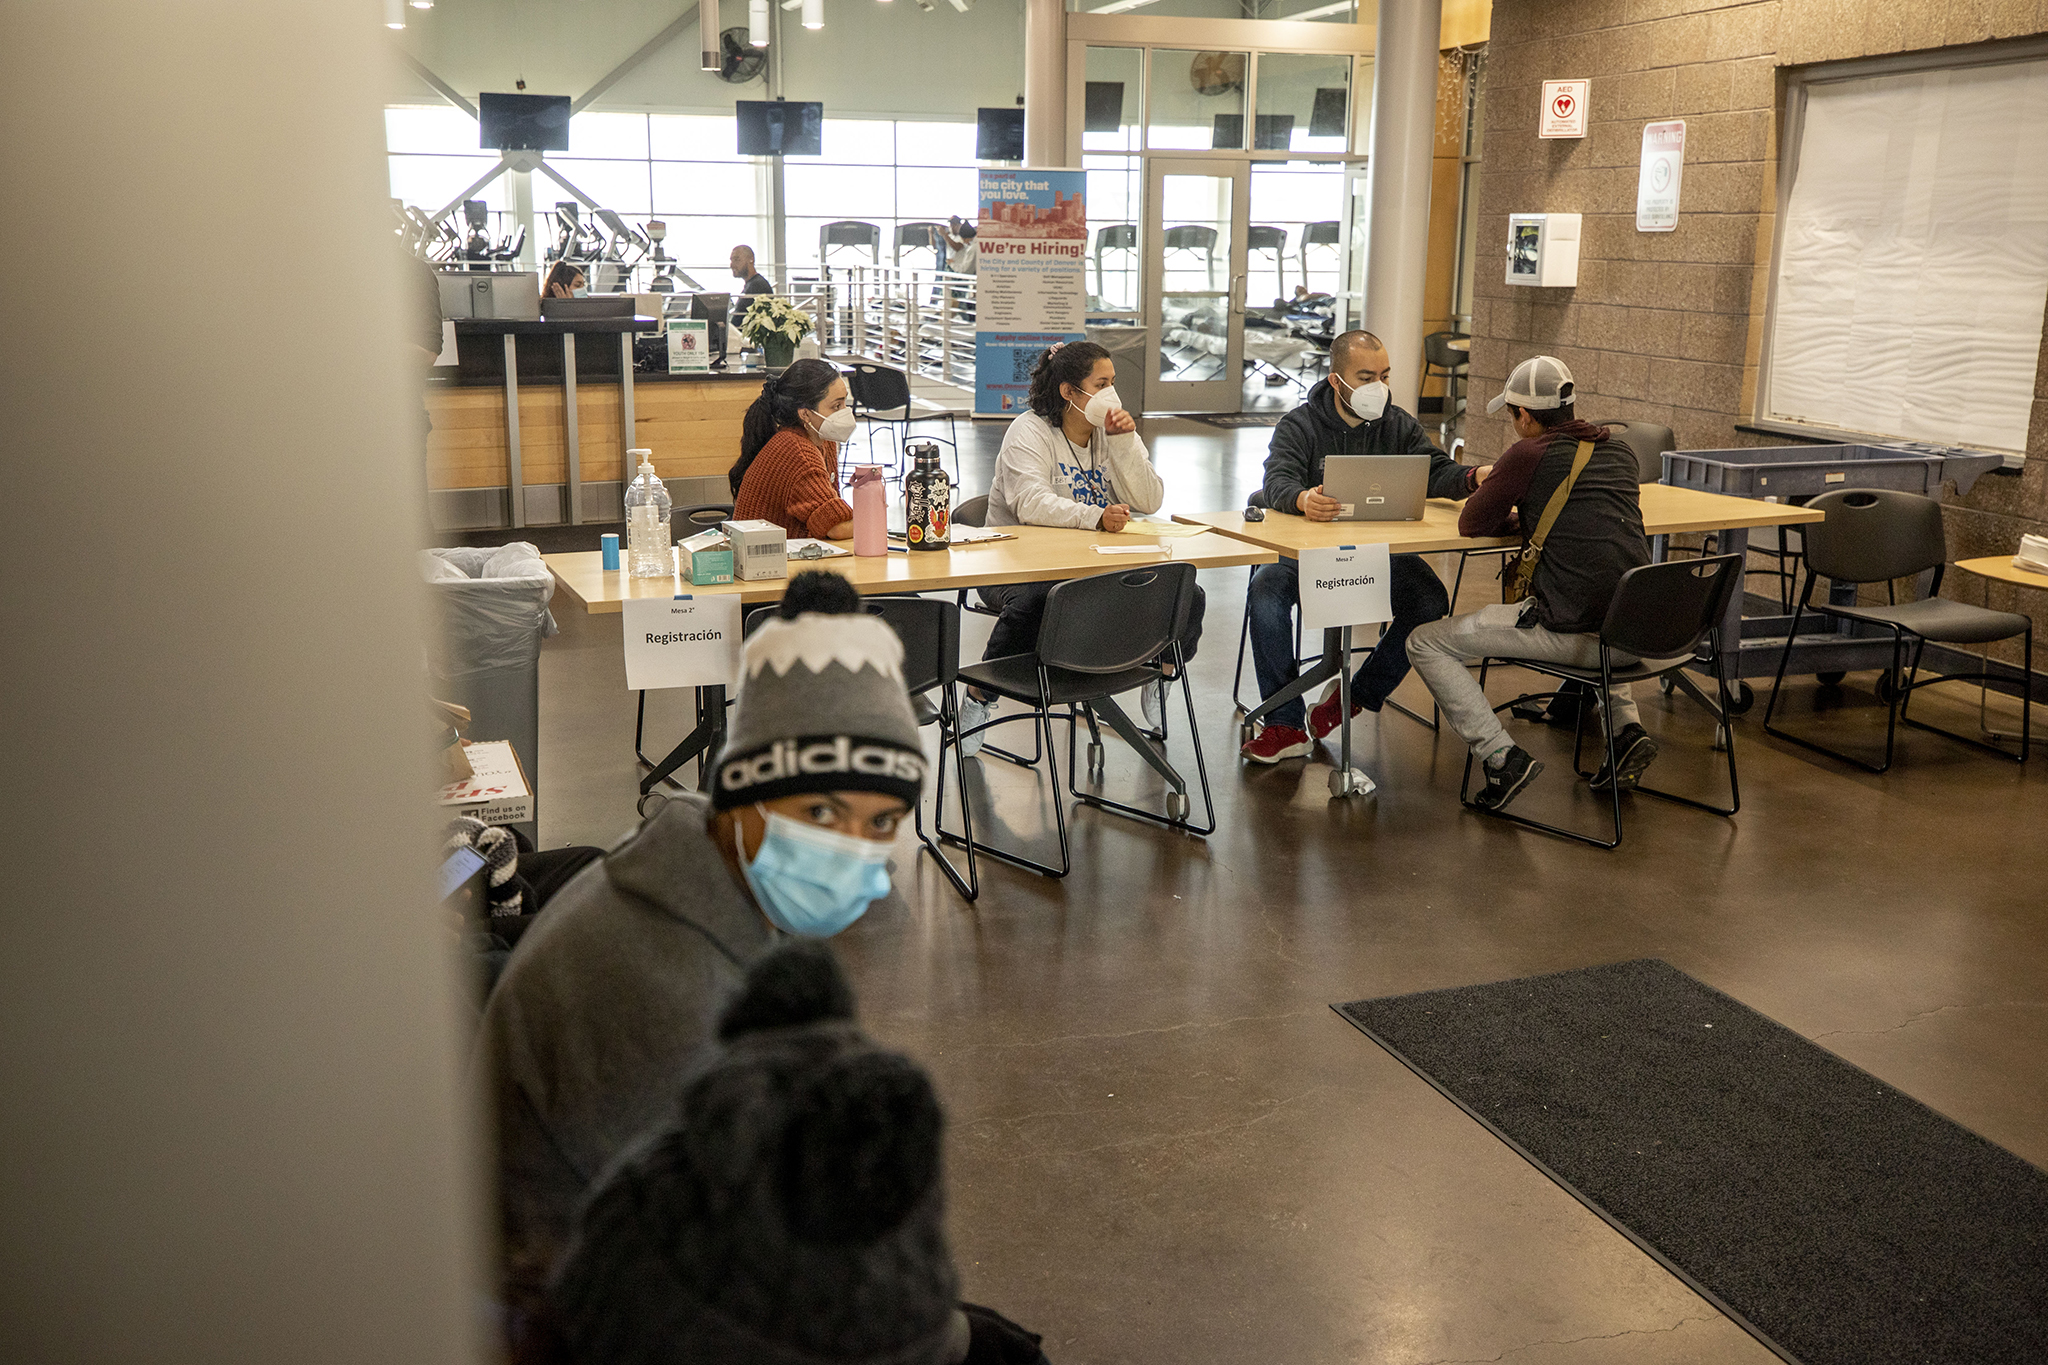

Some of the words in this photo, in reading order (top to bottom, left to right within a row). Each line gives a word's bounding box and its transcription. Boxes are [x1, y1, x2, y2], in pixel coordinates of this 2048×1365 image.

[1646, 131, 1682, 144] WARNING
[980, 179, 999, 190] the
[1000, 180, 1023, 192] city
[1024, 180, 1050, 191] that
[980, 190, 1001, 201] you
[1002, 189, 1029, 200] love.
[979, 241, 1026, 254] We're
[1031, 241, 1084, 258] Hiring!
[995, 334, 1016, 342] Apply
[986, 383, 1031, 391] www.Denver
[1315, 574, 1375, 591] Registración
[645, 628, 722, 646] Registración
[721, 736, 925, 791] adidas
[481, 807, 500, 815] Find
[481, 812, 526, 822] Facebook
